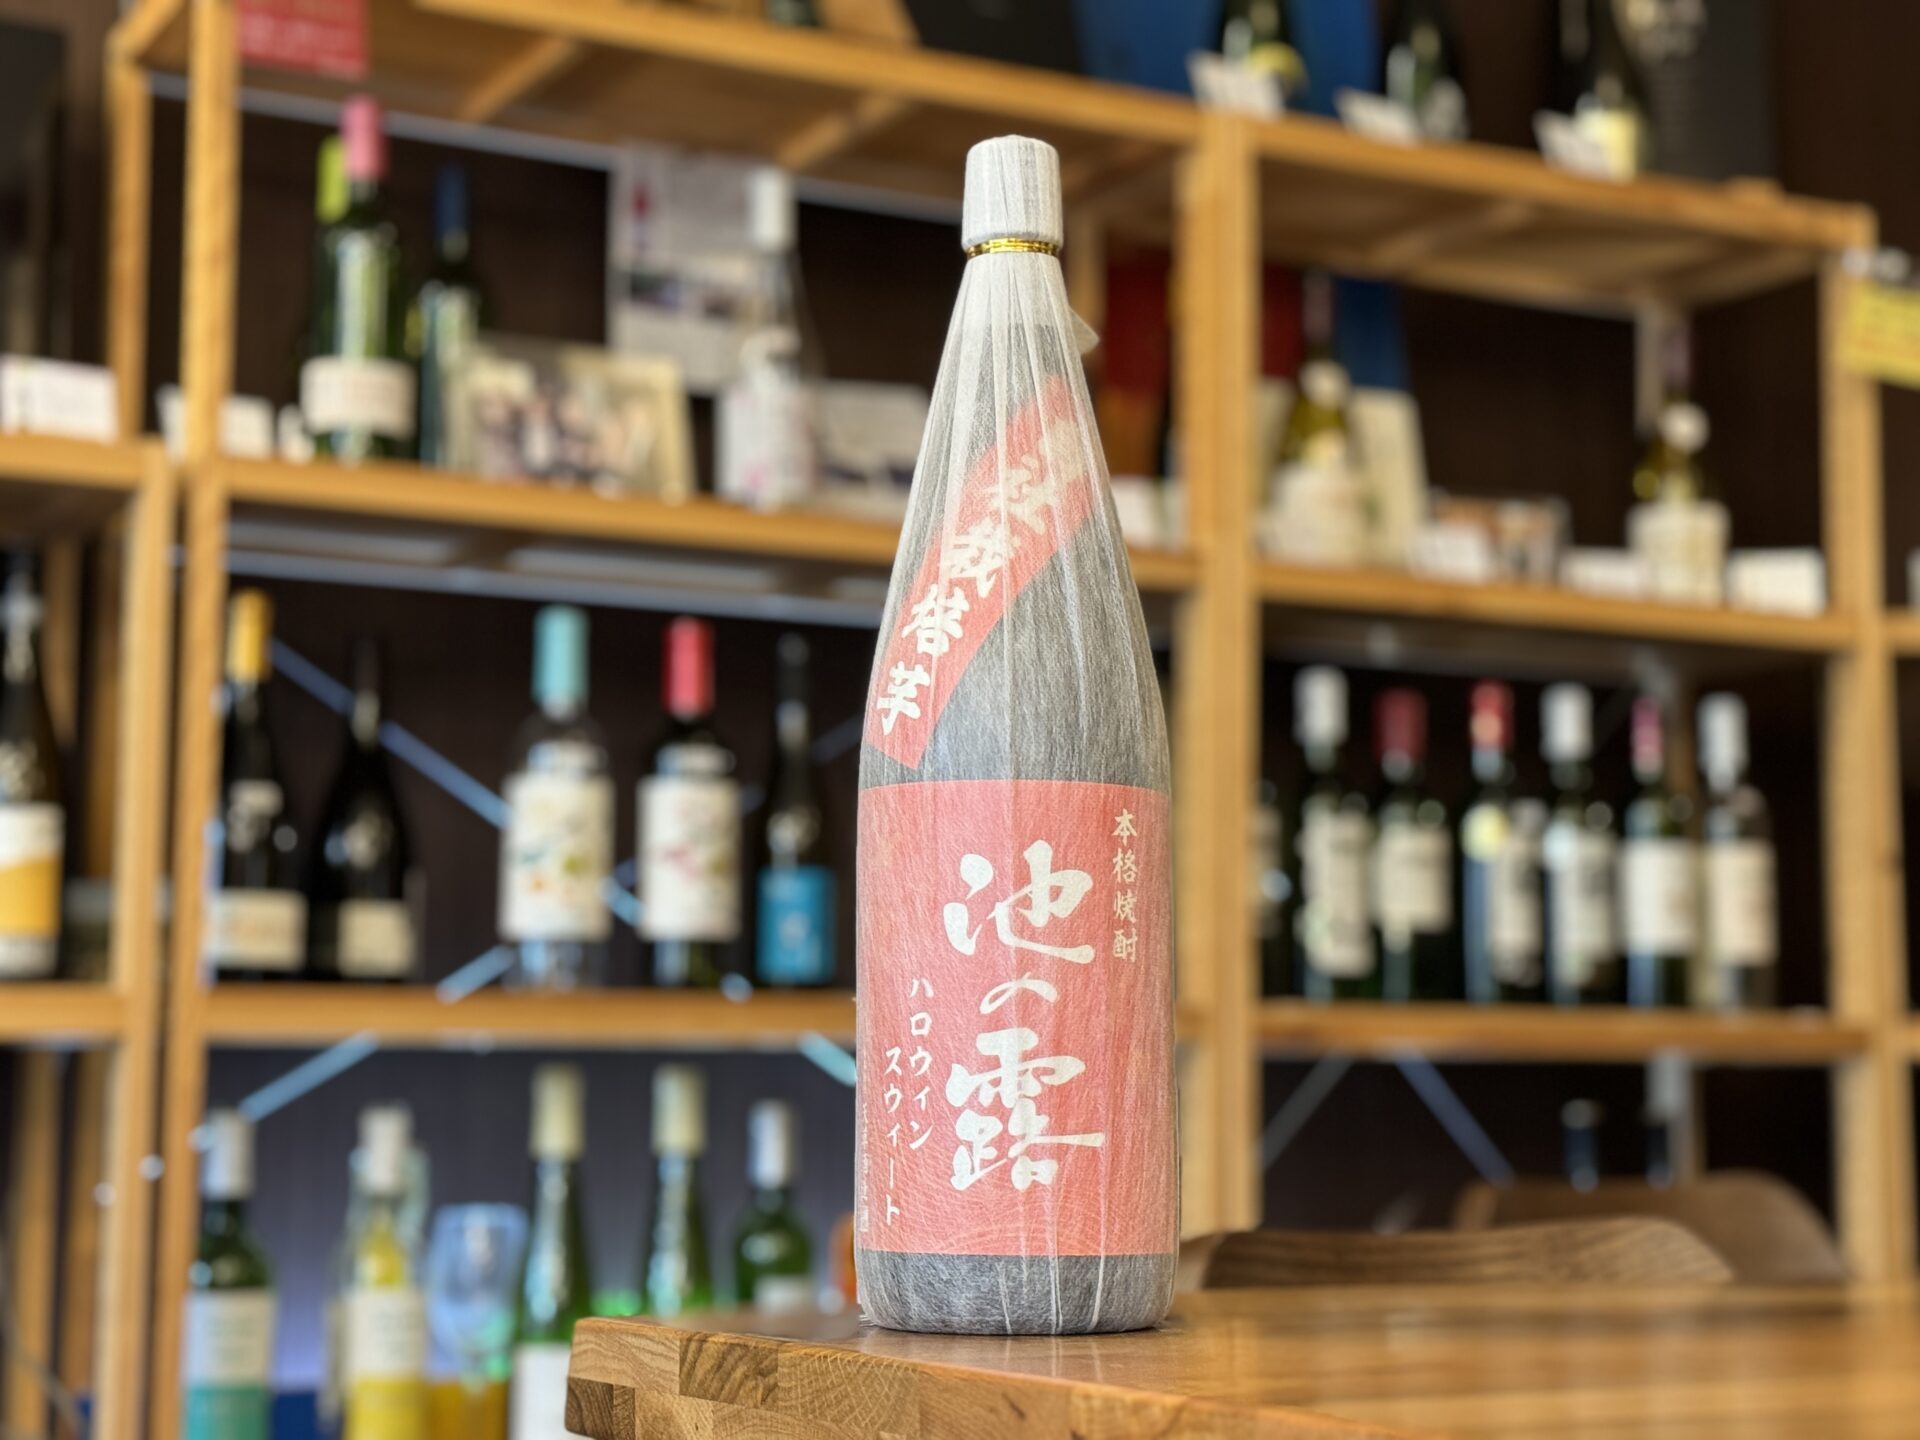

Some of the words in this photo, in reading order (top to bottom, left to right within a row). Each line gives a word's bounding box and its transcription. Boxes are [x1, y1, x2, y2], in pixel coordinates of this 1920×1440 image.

[1112, 808, 1138, 963] 本格焼酎
[943, 839, 1106, 1192] 池の露
